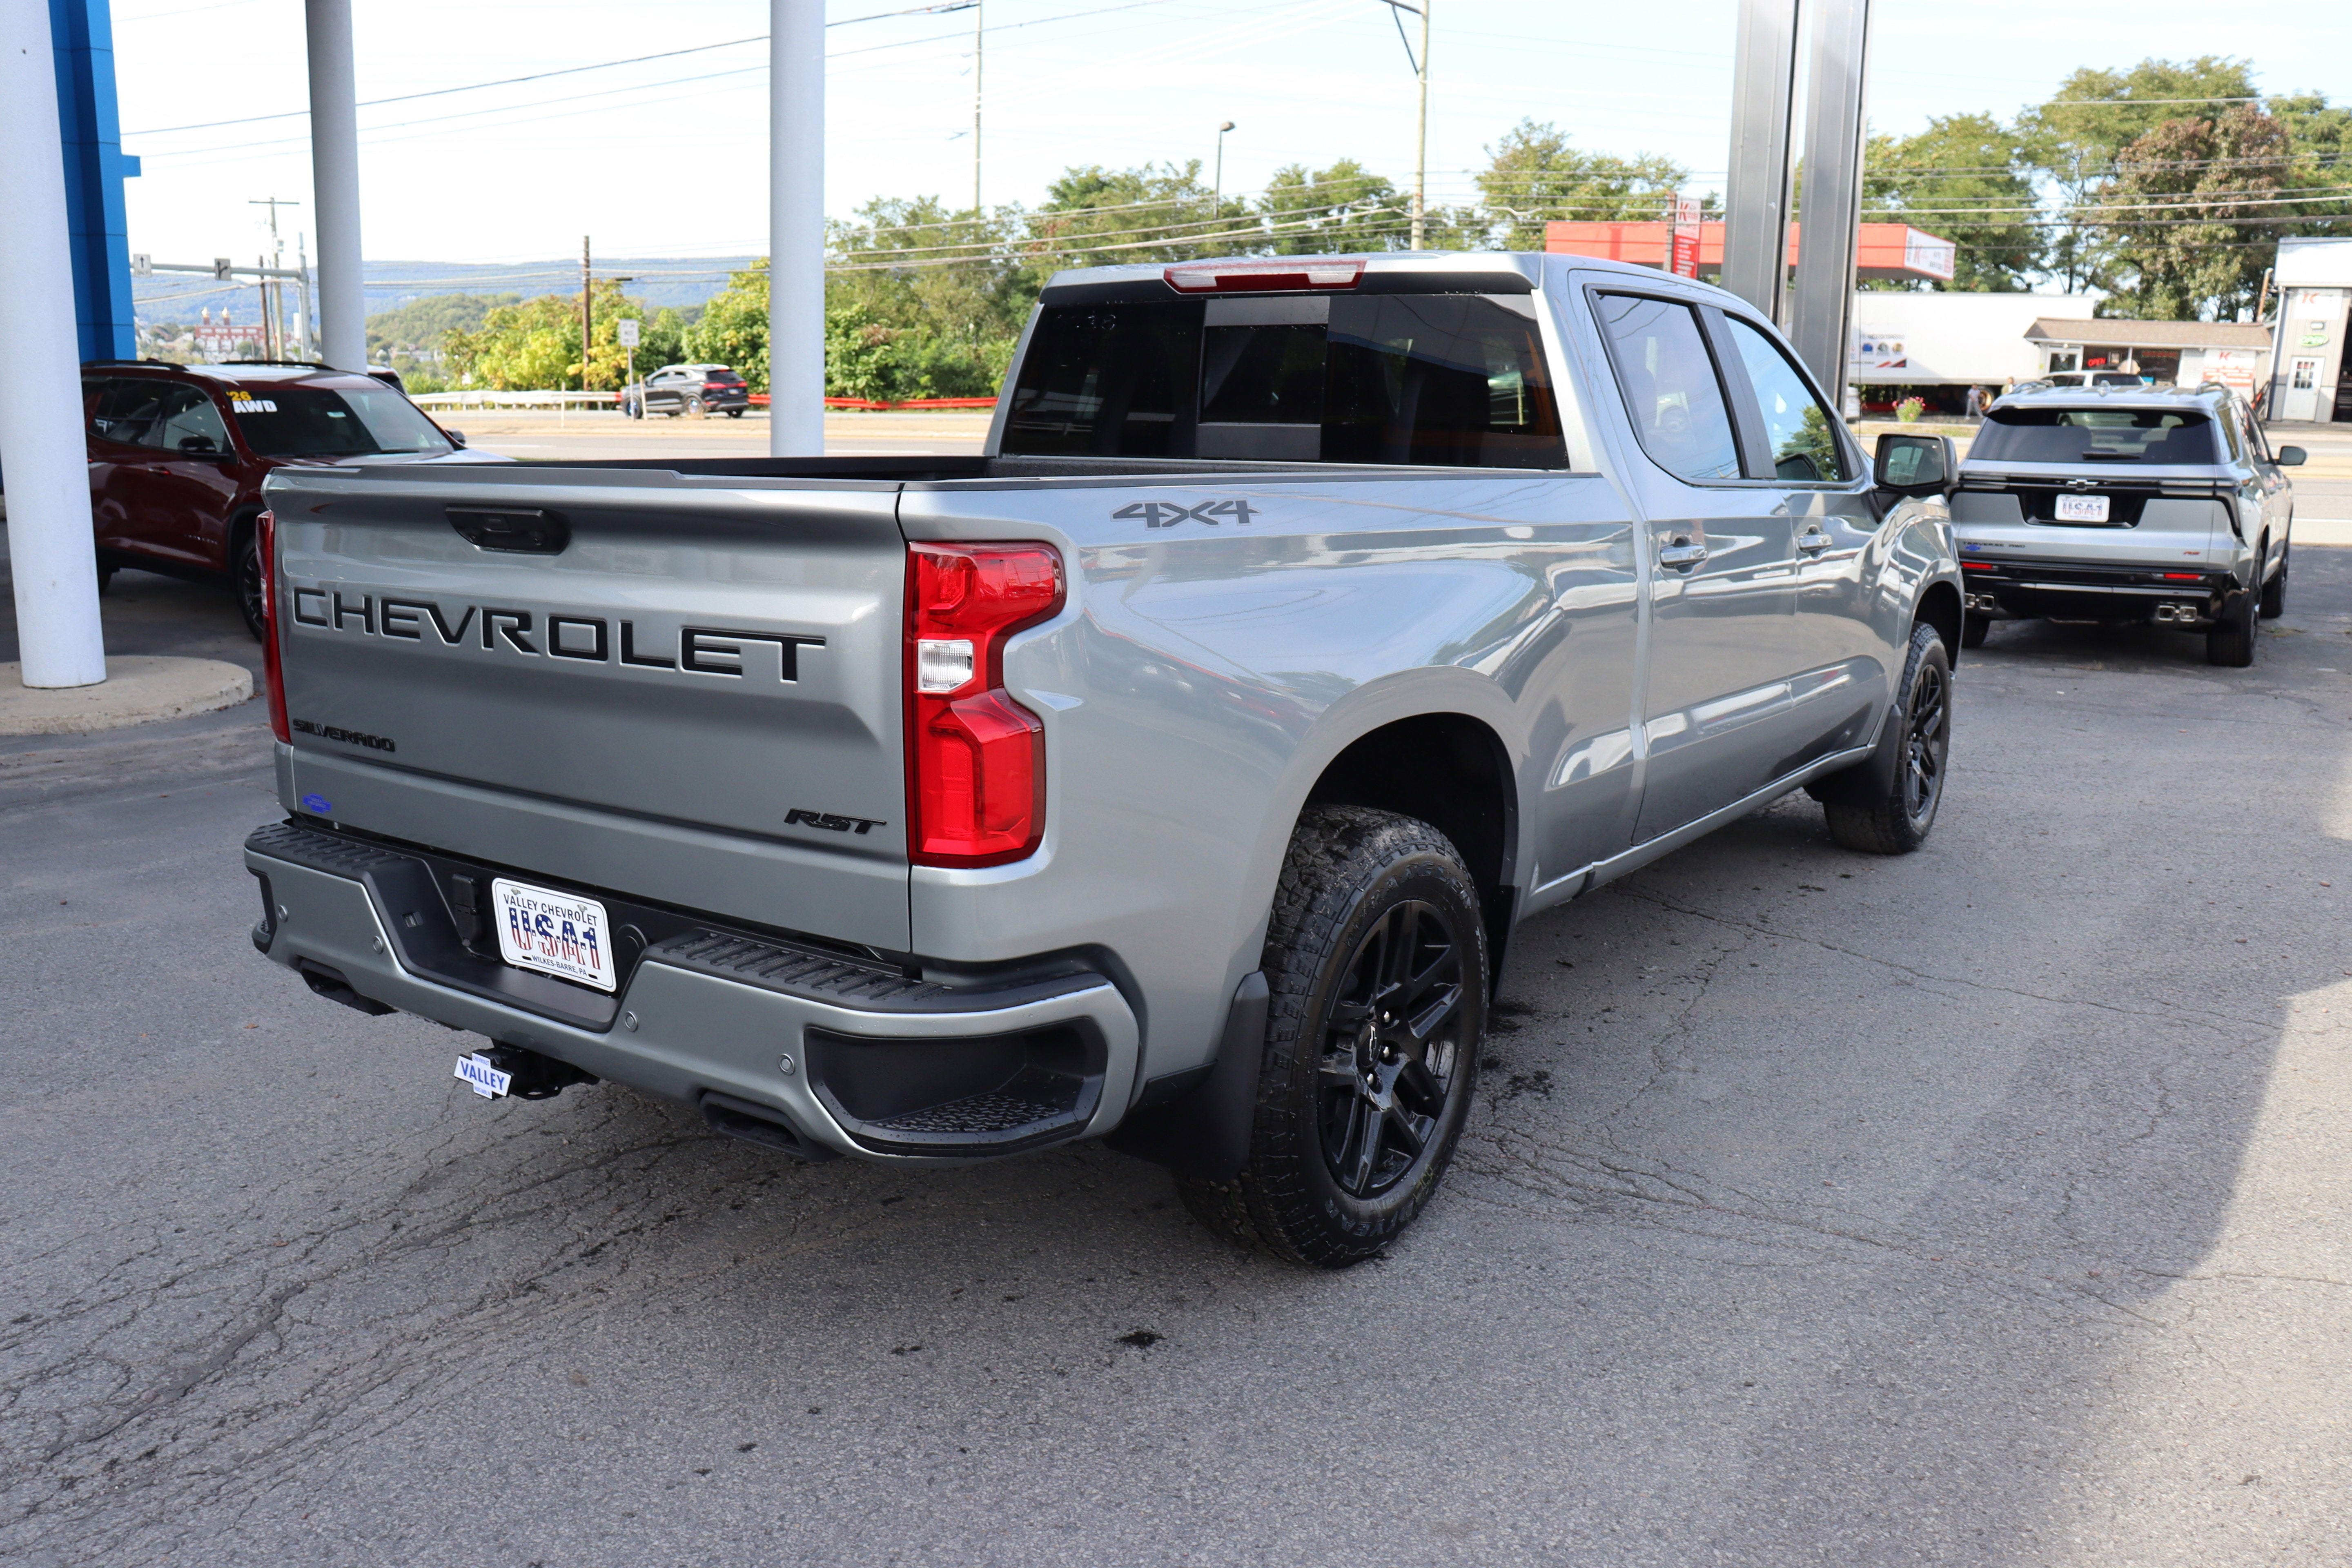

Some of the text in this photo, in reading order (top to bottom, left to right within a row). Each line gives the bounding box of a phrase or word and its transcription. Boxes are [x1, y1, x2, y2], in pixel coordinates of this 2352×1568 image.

[2087, 357, 2106, 367] OPEN
[232, 400, 278, 413] AWD
[292, 587, 826, 684] CHEVROLET
[293, 718, 396, 752] SILVERADO
[784, 808, 887, 834] RST
[503, 894, 597, 926] VALLEY CHEVROLET
[532, 955, 578, 974] WILKES-BARRE,
[460, 1060, 505, 1091] VALLEY
